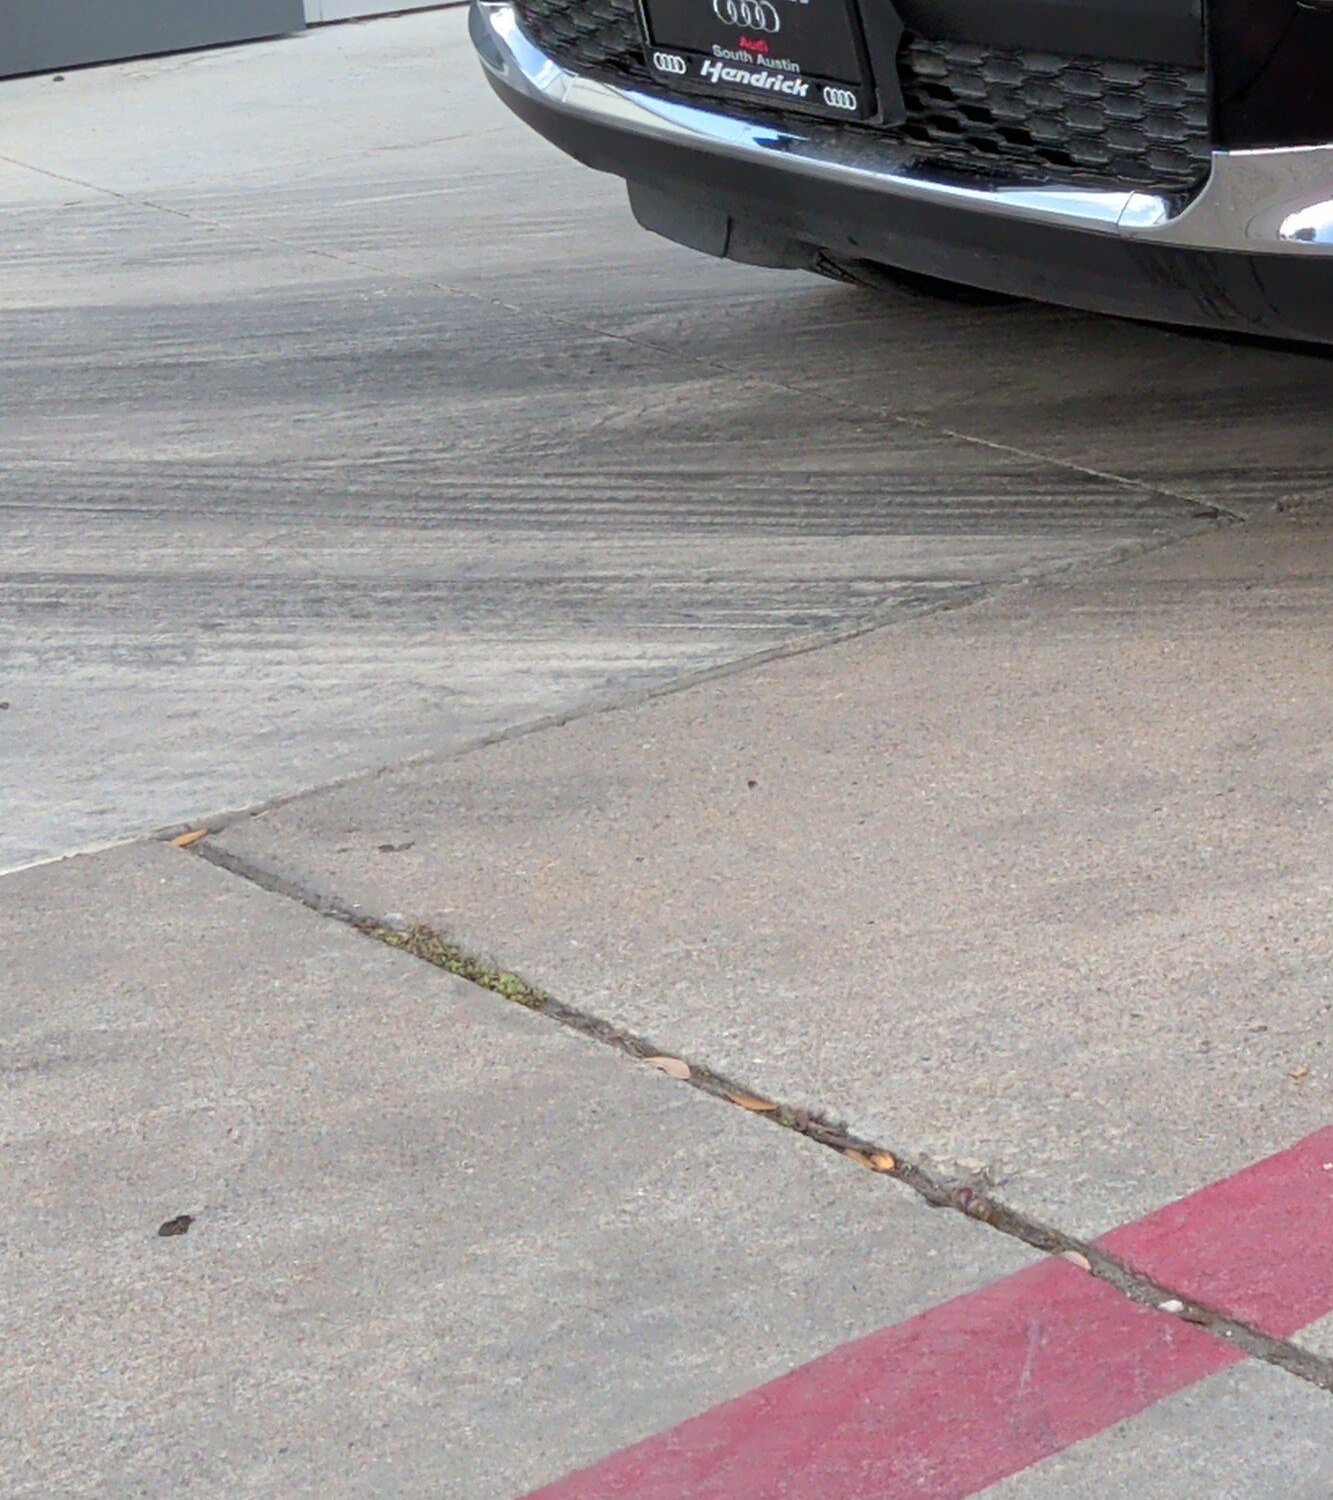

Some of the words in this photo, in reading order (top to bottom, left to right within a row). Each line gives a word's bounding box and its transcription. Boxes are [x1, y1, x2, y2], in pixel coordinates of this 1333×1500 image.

[712, 44, 752, 63] South
[756, 53, 800, 73] Austin
[738, 36, 769, 53] Audi
[700, 59, 809, 97] Hendrick
